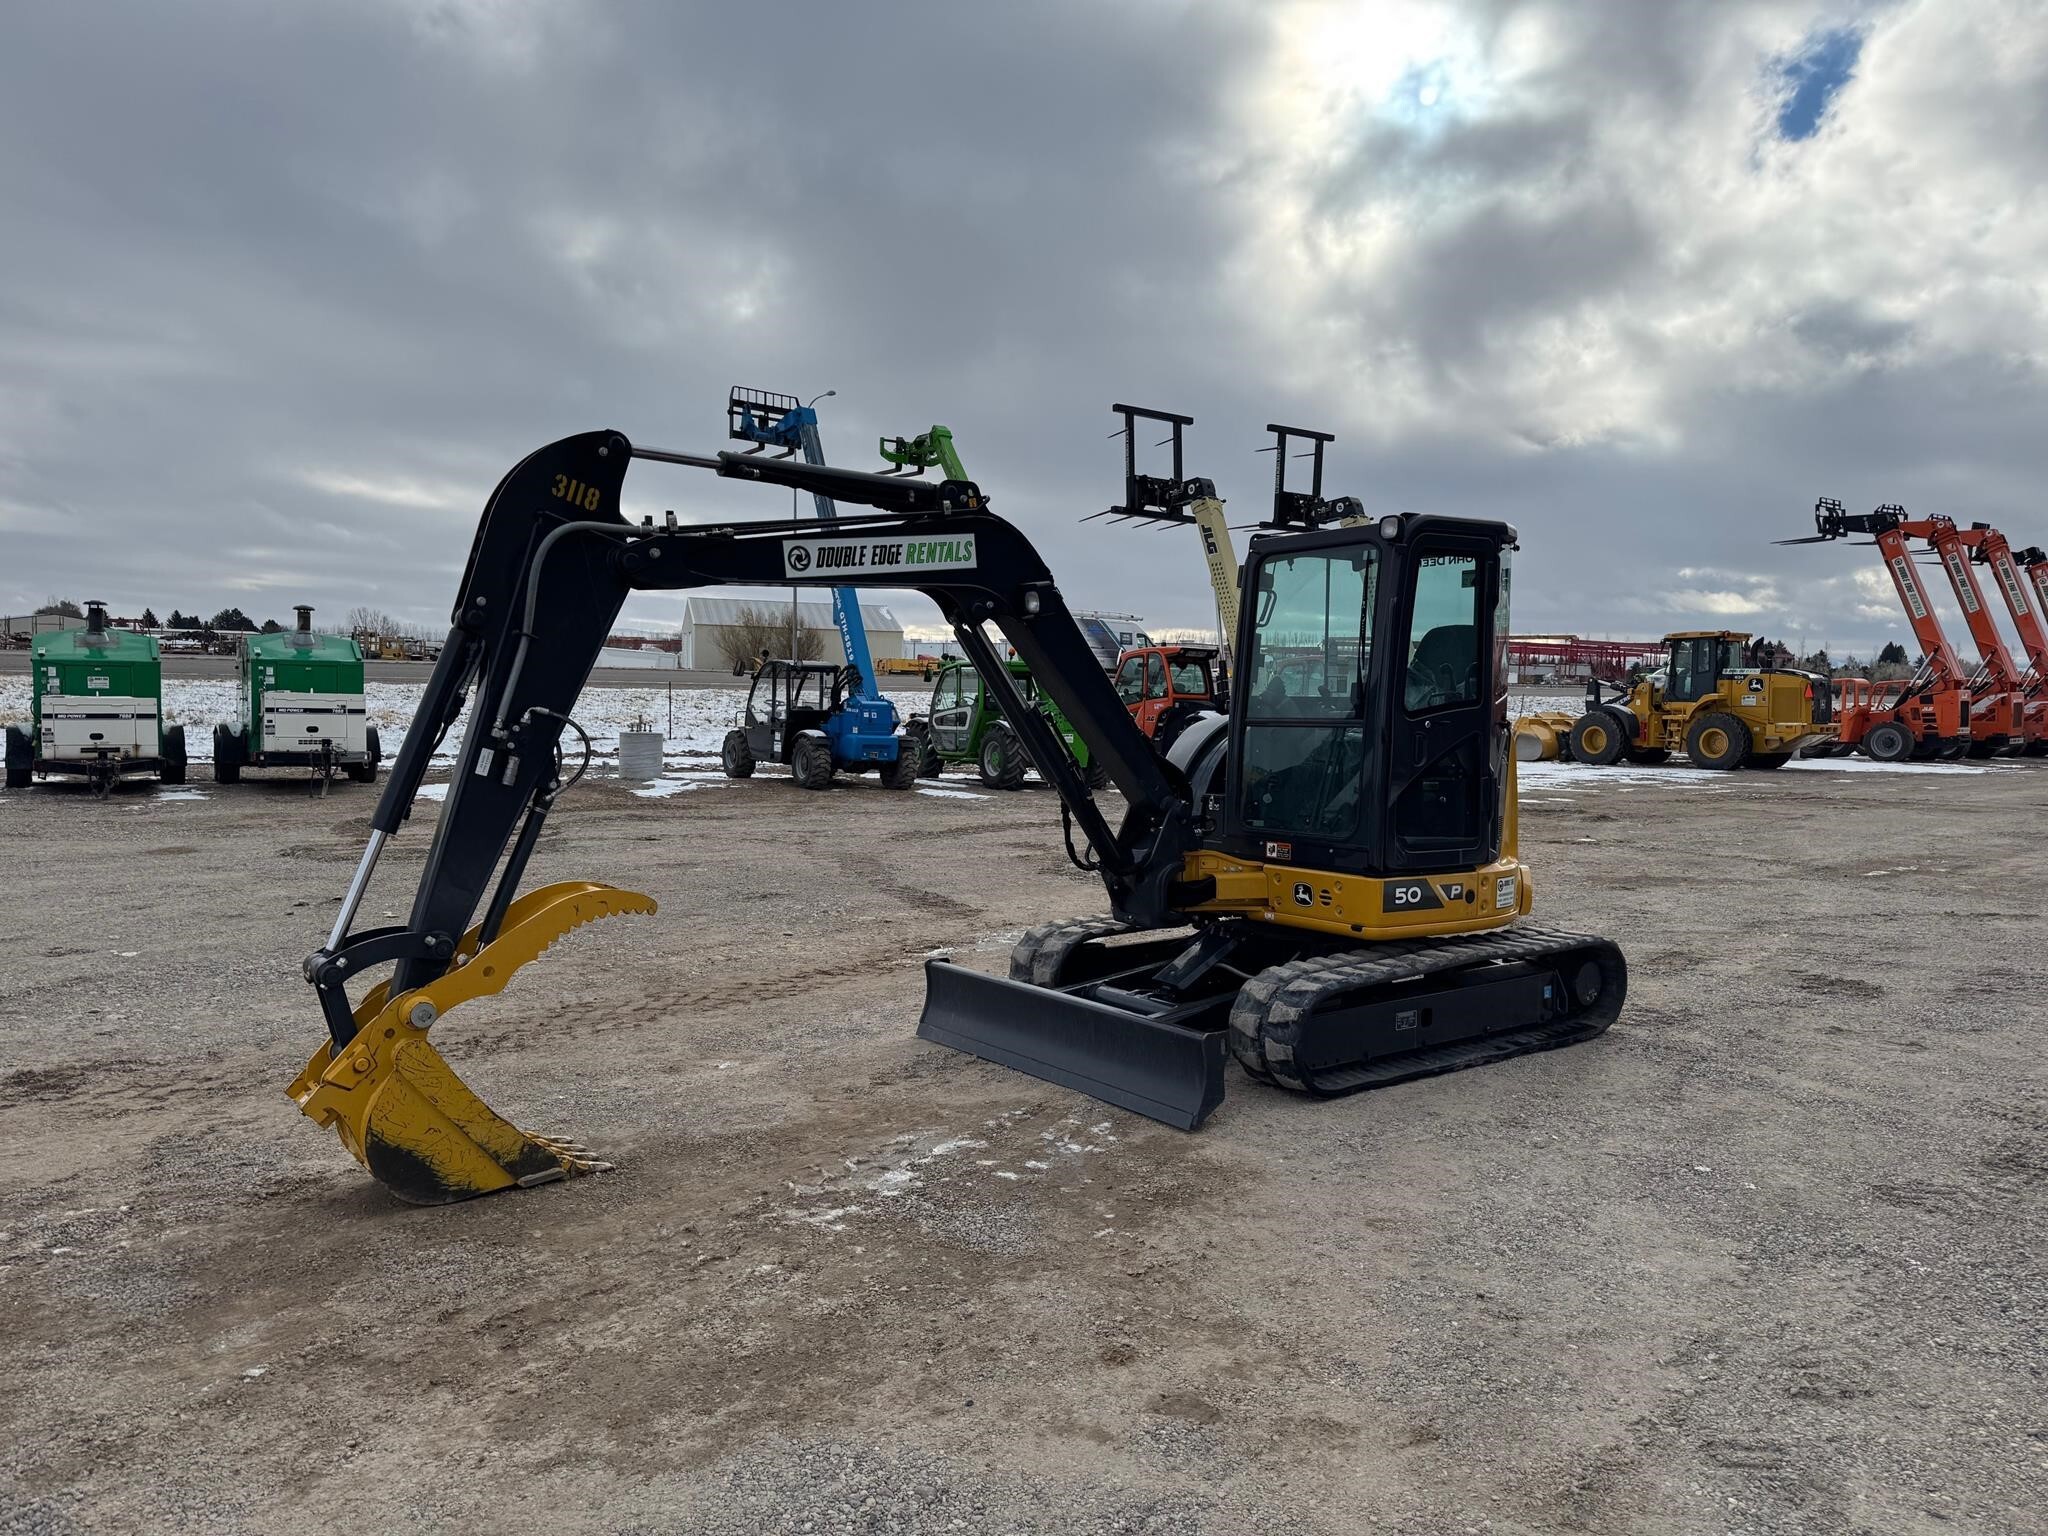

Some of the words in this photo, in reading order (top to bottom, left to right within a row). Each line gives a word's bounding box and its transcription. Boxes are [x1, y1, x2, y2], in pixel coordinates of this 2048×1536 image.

[551, 474, 600, 511] 3118
[1201, 524, 1218, 555] JLG
[816, 545, 868, 569] DOUBLE
[870, 543, 904, 566] EDGE
[905, 540, 973, 565] RENTALS
[1909, 593, 1925, 617] RENTALS
[1395, 886, 1422, 904] 50
[1450, 885, 1462, 899] P
